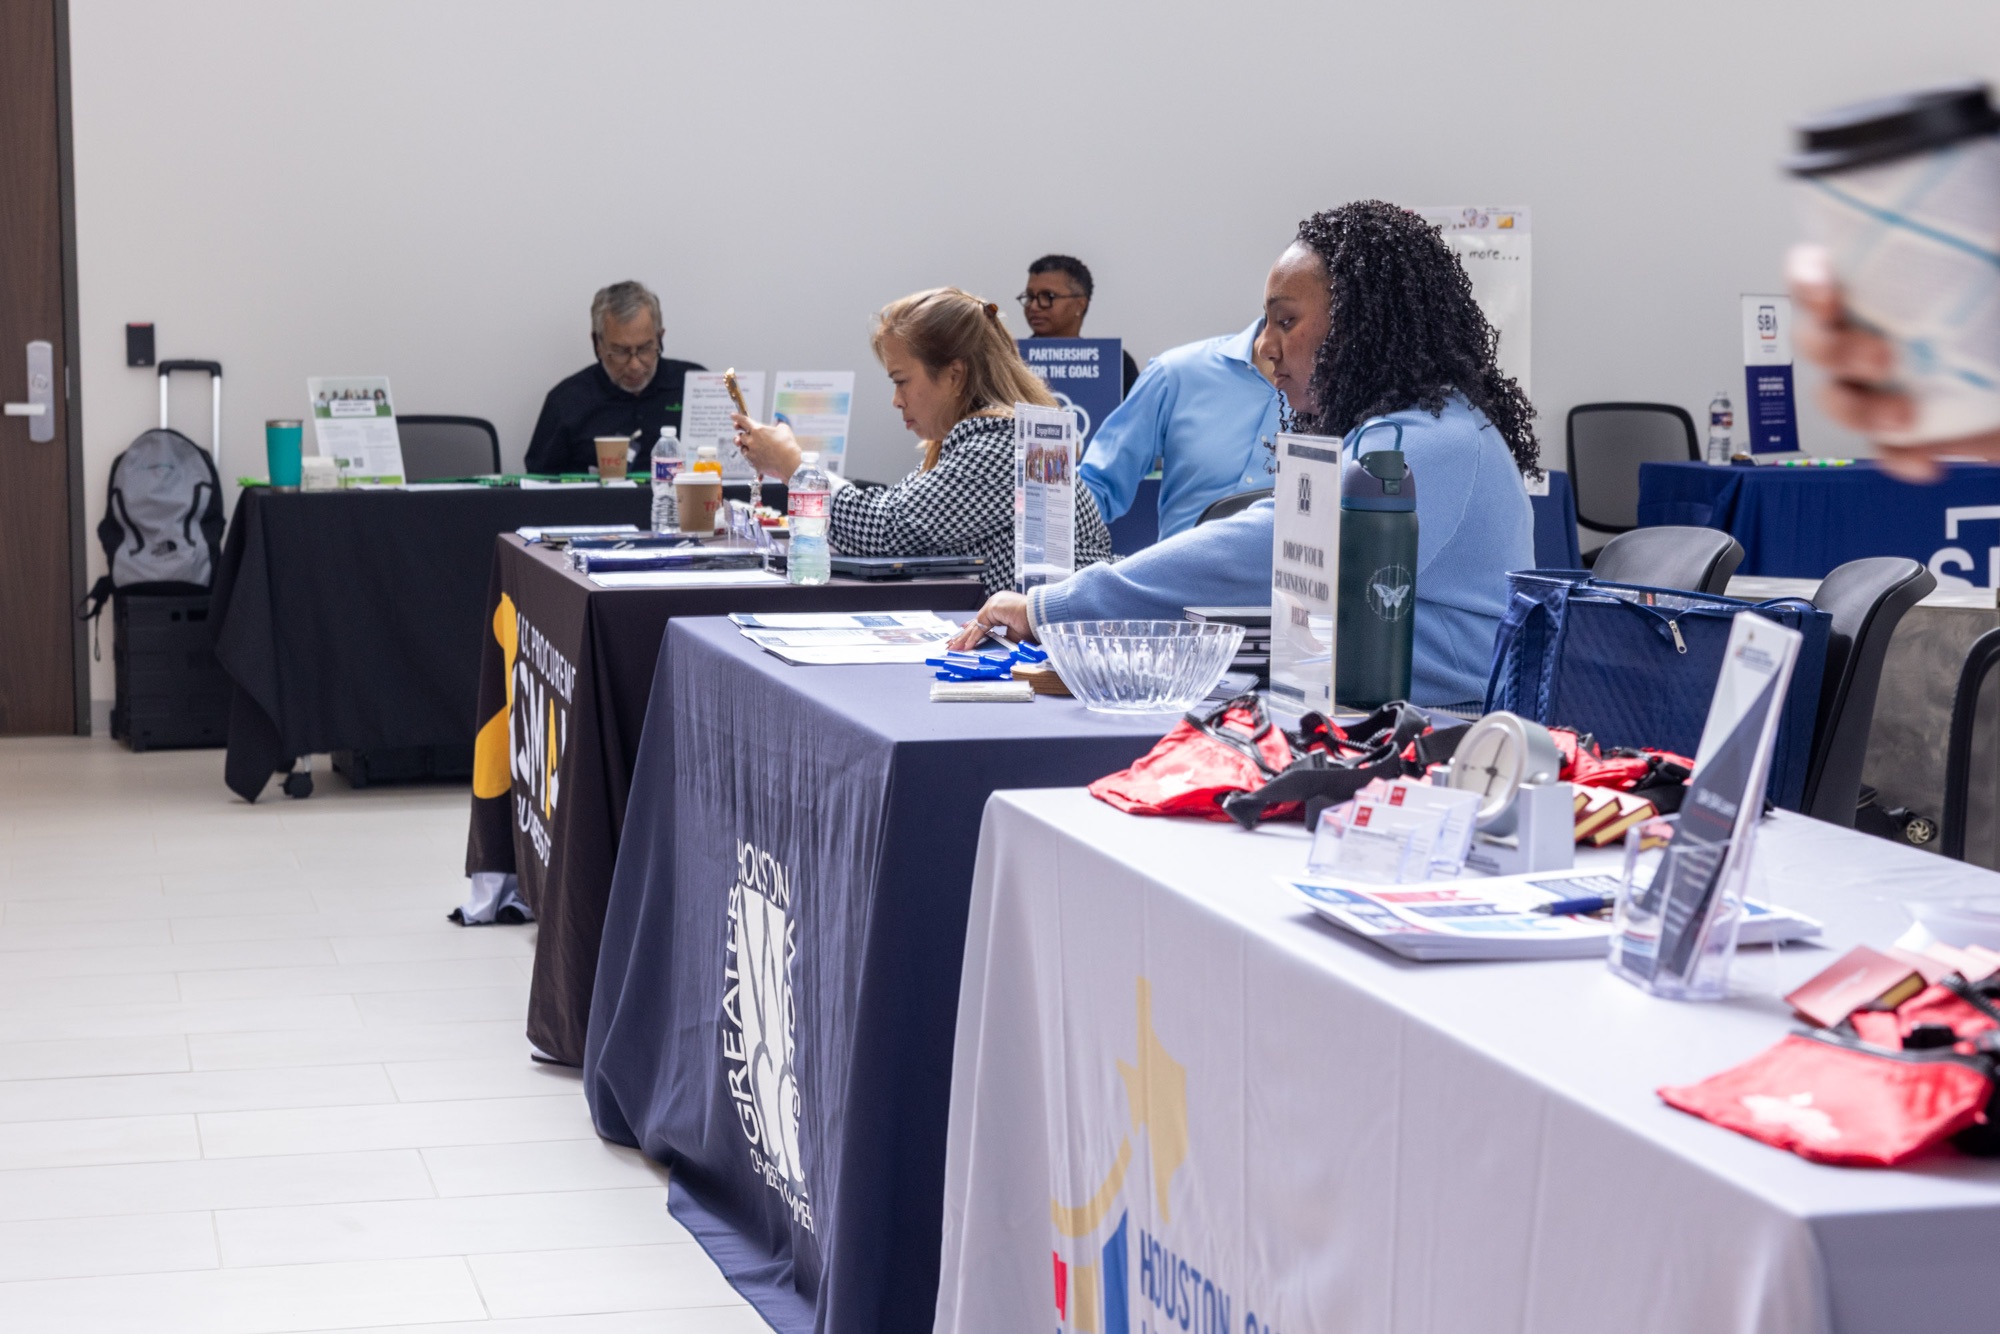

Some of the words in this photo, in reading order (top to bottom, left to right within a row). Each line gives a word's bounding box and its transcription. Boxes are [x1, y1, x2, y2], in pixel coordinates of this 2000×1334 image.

[1029, 347, 1099, 362] PARTNERSHIPS
[1030, 365, 1048, 378] FOR
[1049, 365, 1067, 378] THE
[1068, 365, 1100, 379] GOALS
[1283, 540, 1302, 563] DROP
[1302, 544, 1324, 568] YOUR
[1275, 570, 1308, 597] BUSINESS
[1308, 577, 1329, 602] CARD
[1291, 605, 1310, 628] HERE
[722, 883, 761, 1145] GREATER
[1141, 1228, 1230, 1334] HOUSTON
